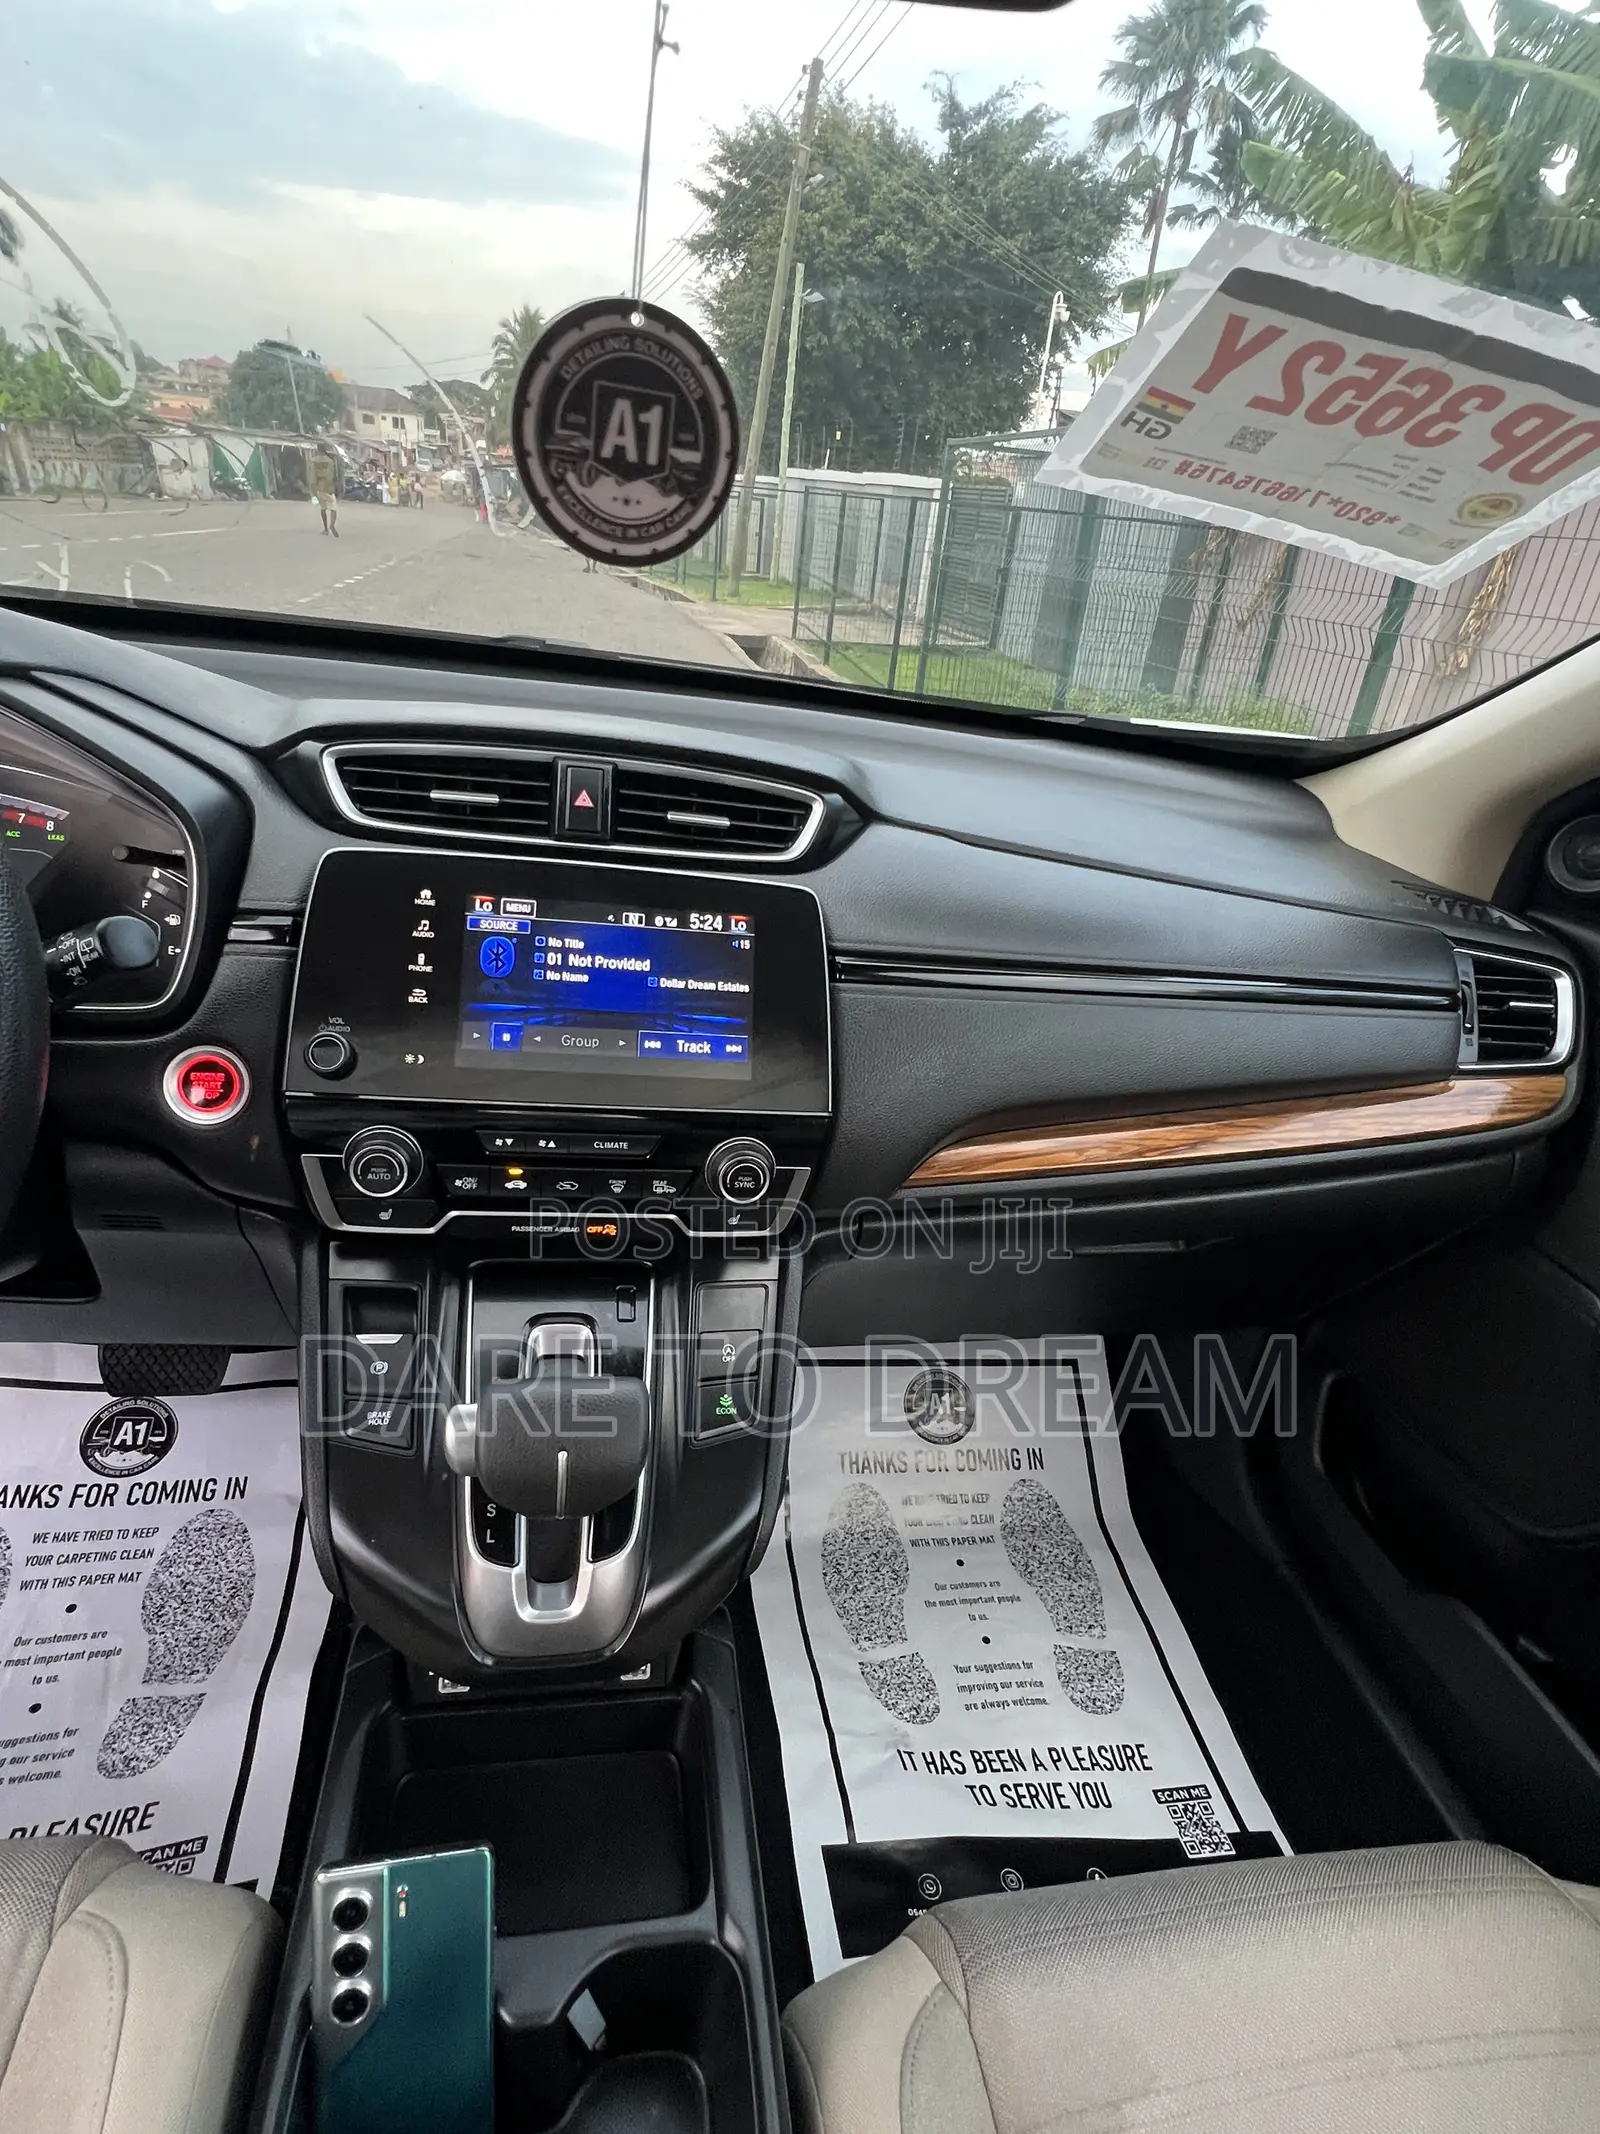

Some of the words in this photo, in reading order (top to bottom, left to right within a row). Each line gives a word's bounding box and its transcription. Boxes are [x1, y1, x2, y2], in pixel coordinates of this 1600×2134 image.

[559, 336, 631, 380] DETAILING
[634, 338, 703, 400] SOLUTIONS
[601, 398, 663, 466] A1
[18, 813, 25, 824] 7
[46, 820, 55, 832] 8
[6, 830, 21, 838] ACC
[142, 900, 149, 909] F
[414, 898, 436, 906] HOME
[475, 898, 493, 912] Lo
[506, 903, 531, 913] MENU
[689, 913, 723, 931] 5:24
[731, 918, 747, 931] Lo
[480, 920, 518, 931] SOURCE
[412, 930, 435, 938] AUDIO
[62, 938, 77, 951] OFF
[548, 937, 563, 948] No
[564, 938, 585, 949] Title
[740, 940, 751, 950] 15
[168, 946, 175, 955] E
[63, 951, 76, 963] INT
[547, 952, 562, 966] 01
[568, 953, 593, 968] Not
[594, 955, 651, 972] Provided
[69, 966, 82, 977] ON
[408, 964, 433, 972] PHONE
[546, 970, 561, 981] No
[562, 971, 589, 983] Name
[660, 977, 686, 989] Dollar
[688, 979, 716, 991] Dream
[718, 981, 750, 993] Estates
[408, 996, 428, 1004] BACK
[328, 1016, 345, 1024] VOL
[561, 1034, 600, 1049] Group
[677, 1040, 711, 1054] Track
[190, 1072, 225, 1081] ENGINE
[191, 1081, 222, 1089] START
[594, 1141, 629, 1150] CLIMATE
[367, 1173, 391, 1181] AUTO
[734, 1181, 756, 1189] SYNC
[586, 1225, 603, 1233] OFF
[722, 1355, 736, 1363] OFF
[100, 1400, 135, 1419] DETAILING
[136, 1399, 169, 1418] SOLUTIONS
[367, 1411, 392, 1419] BRAKE
[715, 1407, 737, 1415] ECON
[368, 1418, 390, 1426] HOLD
[113, 1421, 148, 1446] A1
[838, 1450, 908, 1474] THANKS
[914, 1450, 949, 1473] FOR
[956, 1447, 1021, 1472] COMING
[1026, 1447, 1044, 1470] IN
[0, 1484, 63, 1508] ANKS
[68, 1483, 119, 1508] FOR
[126, 1477, 217, 1505] COMING
[224, 1476, 249, 1500] IN
[935, 1493, 958, 1504] TRIED
[959, 1493, 970, 1504] TO
[972, 1493, 990, 1504] KEEP
[487, 1503, 496, 1517] S
[970, 1514, 995, 1525] CLEAN
[32, 1532, 50, 1544] WE
[52, 1531, 81, 1543] HAVE
[82, 1529, 114, 1541] TRIED
[116, 1528, 130, 1540] TO
[132, 1527, 160, 1539] KEEP
[487, 1529, 495, 1543] L
[909, 1538, 931, 1547] WITH
[931, 1537, 950, 1547] THIS
[951, 1536, 978, 1546] PAPER
[979, 1535, 996, 1544] MAT
[25, 1555, 54, 1567] YOUR
[56, 1550, 118, 1566] CARPETING
[120, 1548, 155, 1560] CLEAN
[20, 1579, 49, 1592] WITH
[52, 1576, 77, 1589] THIS
[78, 1573, 115, 1587] PAPER
[118, 1571, 143, 1583] MAT
[934, 1582, 947, 1591] Our
[950, 1580, 987, 1590] customers
[924, 1600, 937, 1608] the
[939, 1598, 958, 1607] most
[959, 1596, 996, 1606] important
[997, 1594, 1021, 1604] people
[968, 1613, 977, 1621] to
[13, 1636, 33, 1647] Our
[34, 1631, 88, 1645] customers
[90, 1630, 108, 1640] are
[4, 1655, 31, 1668] most
[33, 1650, 86, 1667] important
[87, 1646, 122, 1661] people
[953, 1664, 971, 1674] Your
[974, 1661, 1021, 1673] suggestions
[1022, 1660, 1034, 1669] for
[32, 1675, 42, 1685] to
[45, 1674, 60, 1683] us.
[956, 1680, 999, 1694] improving
[1000, 1681, 1013, 1689] our
[1015, 1678, 1044, 1688] service
[964, 1703, 978, 1711] are
[981, 1699, 1010, 1710] always
[0, 1730, 60, 1749] uggestions
[62, 1727, 80, 1738] for
[9, 1755, 29, 1765] our
[31, 1748, 75, 1763] service
[897, 1749, 918, 1772] IT
[921, 1750, 967, 1775] HAS
[969, 1748, 1028, 1774] BEEN
[1031, 1747, 1048, 1771] A
[1048, 1744, 1153, 1772] PLEASURE
[8, 1769, 62, 1785] welcome.
[965, 1784, 997, 1807] TO
[999, 1781, 1071, 1809] SERVE
[1068, 1781, 1112, 1808] YOU
[1156, 1789, 1190, 1801] SCAN
[1192, 1786, 1209, 1798] ME
[141, 1843, 175, 1862] CAN
[180, 1839, 204, 1854] ME
